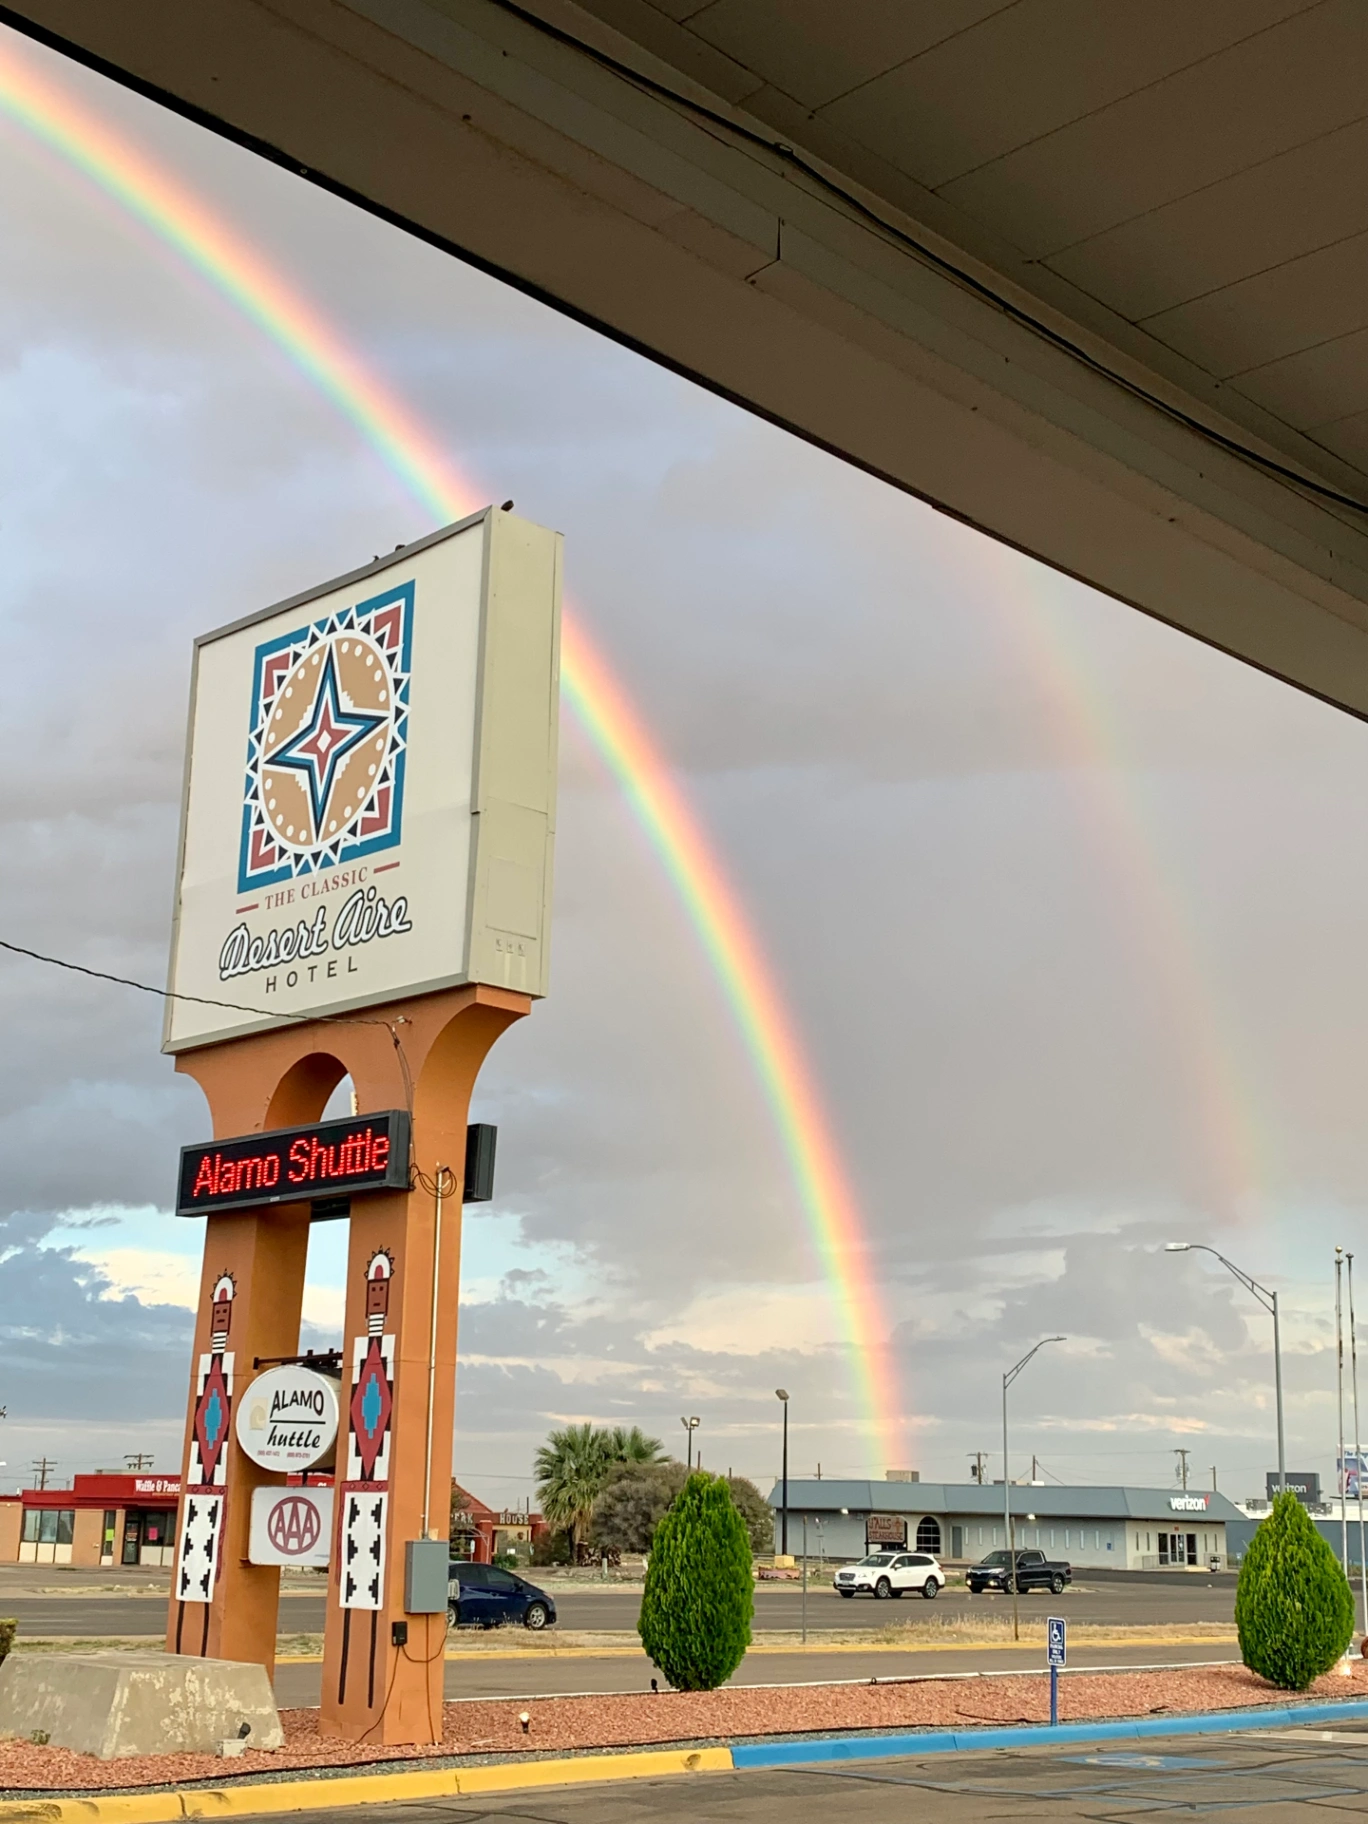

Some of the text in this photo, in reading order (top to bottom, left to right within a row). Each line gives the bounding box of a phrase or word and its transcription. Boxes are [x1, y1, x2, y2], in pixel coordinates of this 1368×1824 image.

[265, 867, 368, 910] THE CLASSIC
[219, 885, 413, 982] Desert Aire
[265, 956, 358, 994] HOTEL
[192, 1128, 390, 1197] Alamo Shuttle
[269, 1390, 324, 1419] ALAMO
[266, 1424, 320, 1448] huttle
[135, 1479, 155, 1492] Waffle
[155, 1479, 163, 1492] &
[1170, 1494, 1206, 1511] verizon
[270, 1498, 318, 1552] AAA
[499, 1514, 529, 1525] HOUSE
